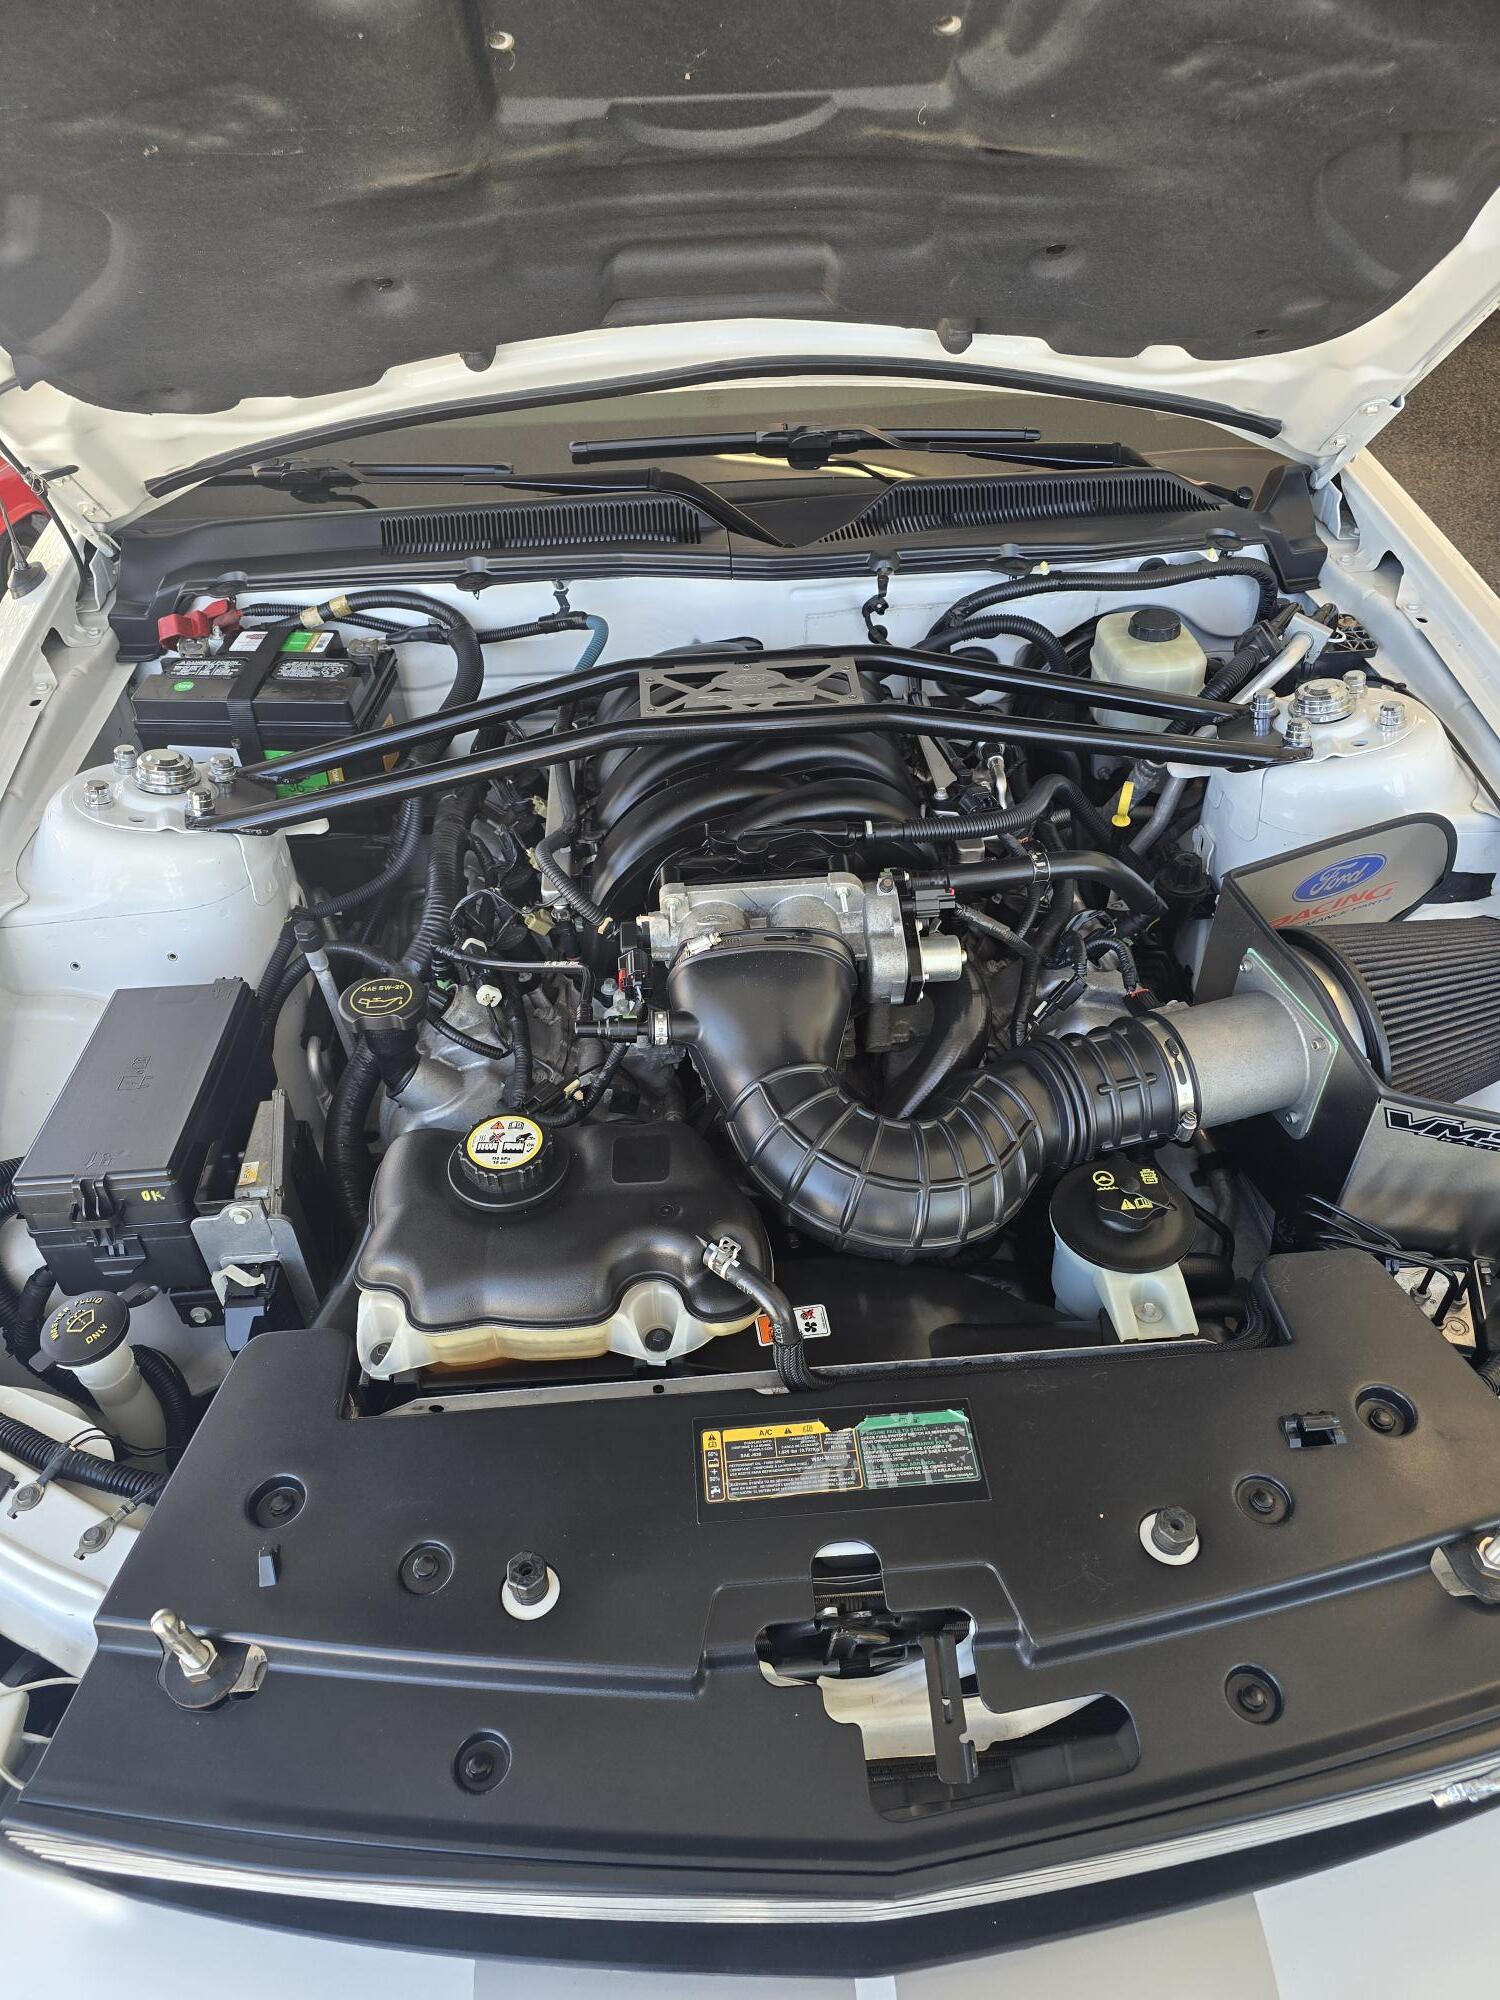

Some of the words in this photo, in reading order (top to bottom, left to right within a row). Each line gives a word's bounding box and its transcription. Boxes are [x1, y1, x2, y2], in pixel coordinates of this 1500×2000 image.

[1310, 861, 1370, 896] Ford
[1269, 881, 1398, 928] RACING
[141, 1190, 165, 1202] OK
[74, 1296, 103, 1306] FLUID
[85, 1323, 108, 1345] ONLY
